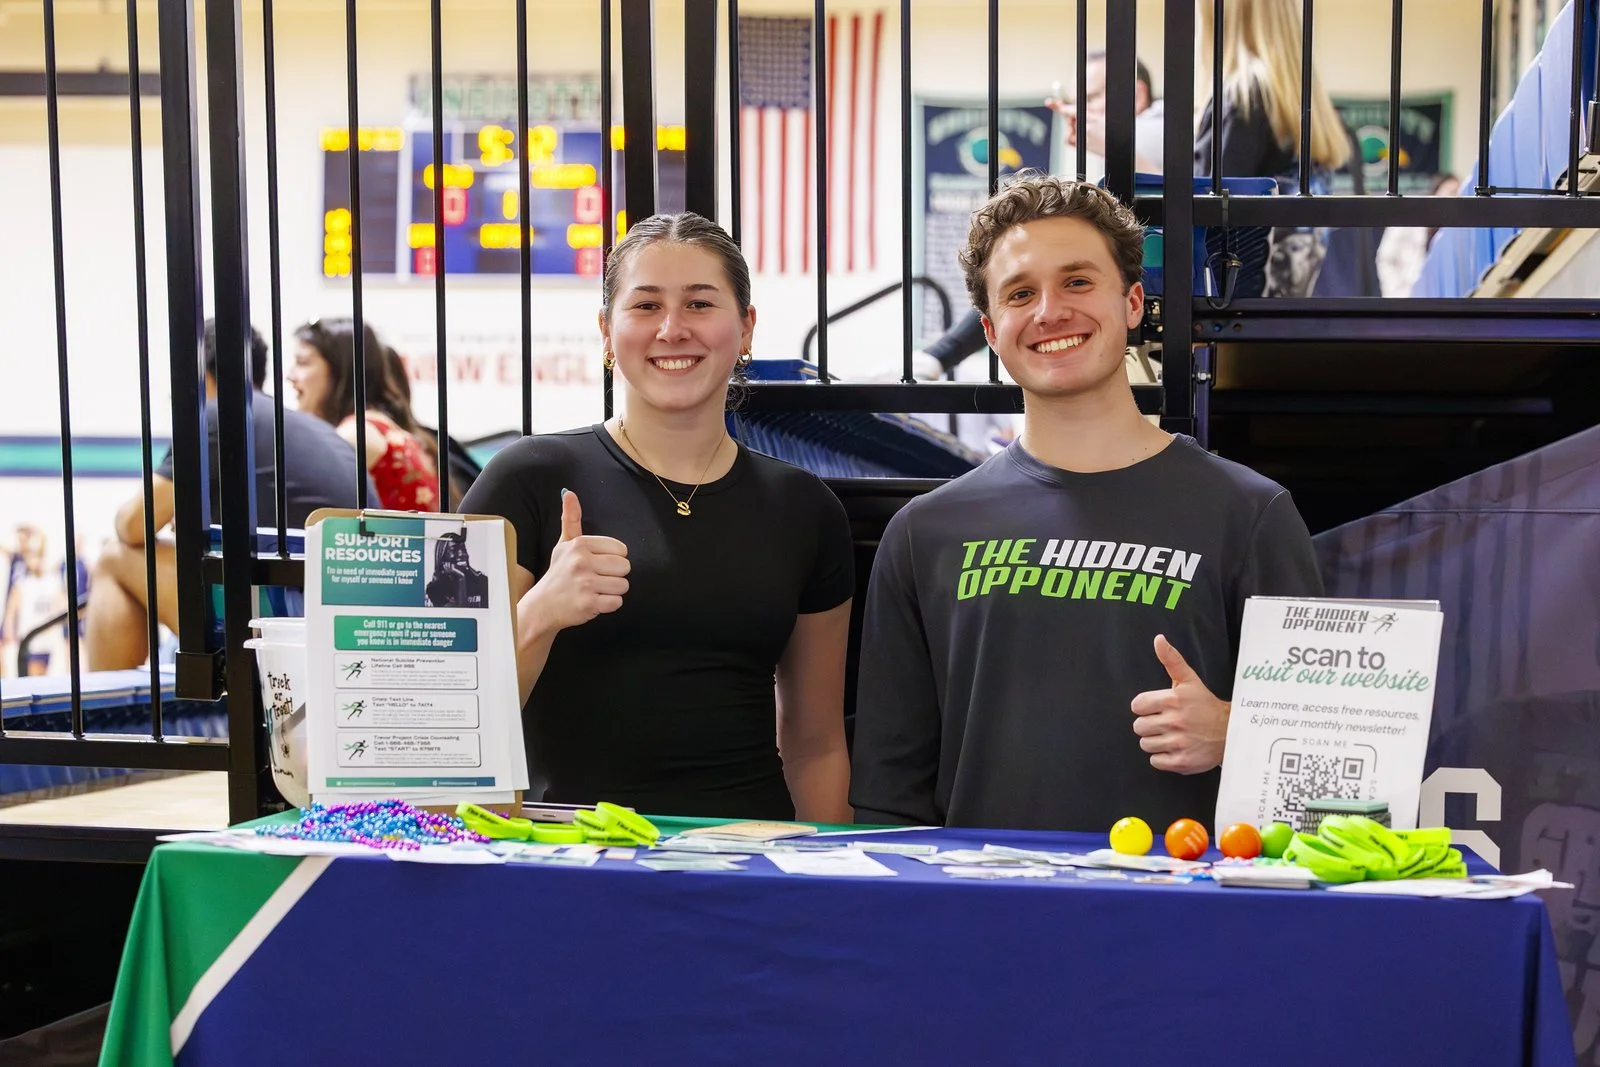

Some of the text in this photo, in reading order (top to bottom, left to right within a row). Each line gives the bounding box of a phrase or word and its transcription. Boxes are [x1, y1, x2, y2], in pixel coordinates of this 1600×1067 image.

[335, 533, 409, 548] SUPPORT
[325, 547, 421, 563] RESOURCES
[961, 538, 1202, 582] THE HIDDEN
[341, 575, 360, 585] myself
[368, 577, 393, 585] someone
[398, 576, 414, 585] know
[343, 567, 357, 576] need
[358, 567, 365, 575] of
[365, 567, 395, 577] immediate
[396, 569, 418, 578] support
[957, 566, 1192, 610] OPPONENT
[1286, 606, 1370, 622] THE HIDDEN
[363, 619, 446, 630] Call 911 or go to the nearest
[1282, 618, 1367, 634] OPPONENT
[354, 629, 387, 638] emergency
[410, 630, 421, 638] you
[430, 631, 456, 639] someone
[357, 636, 453, 648] you know is in immediate danger
[1286, 646, 1386, 670] scan to
[267, 671, 291, 691] trick
[1241, 660, 1431, 692] visit our website
[273, 692, 283, 702] or
[1240, 697, 1420, 722] Learn more, access free resources,
[1250, 713, 1407, 736] & join our monthly newsletter!
[1302, 738, 1348, 748] SCAN ME
[1257, 770, 1270, 819] SCAN ME
[1368, 779, 1378, 801] SCA
